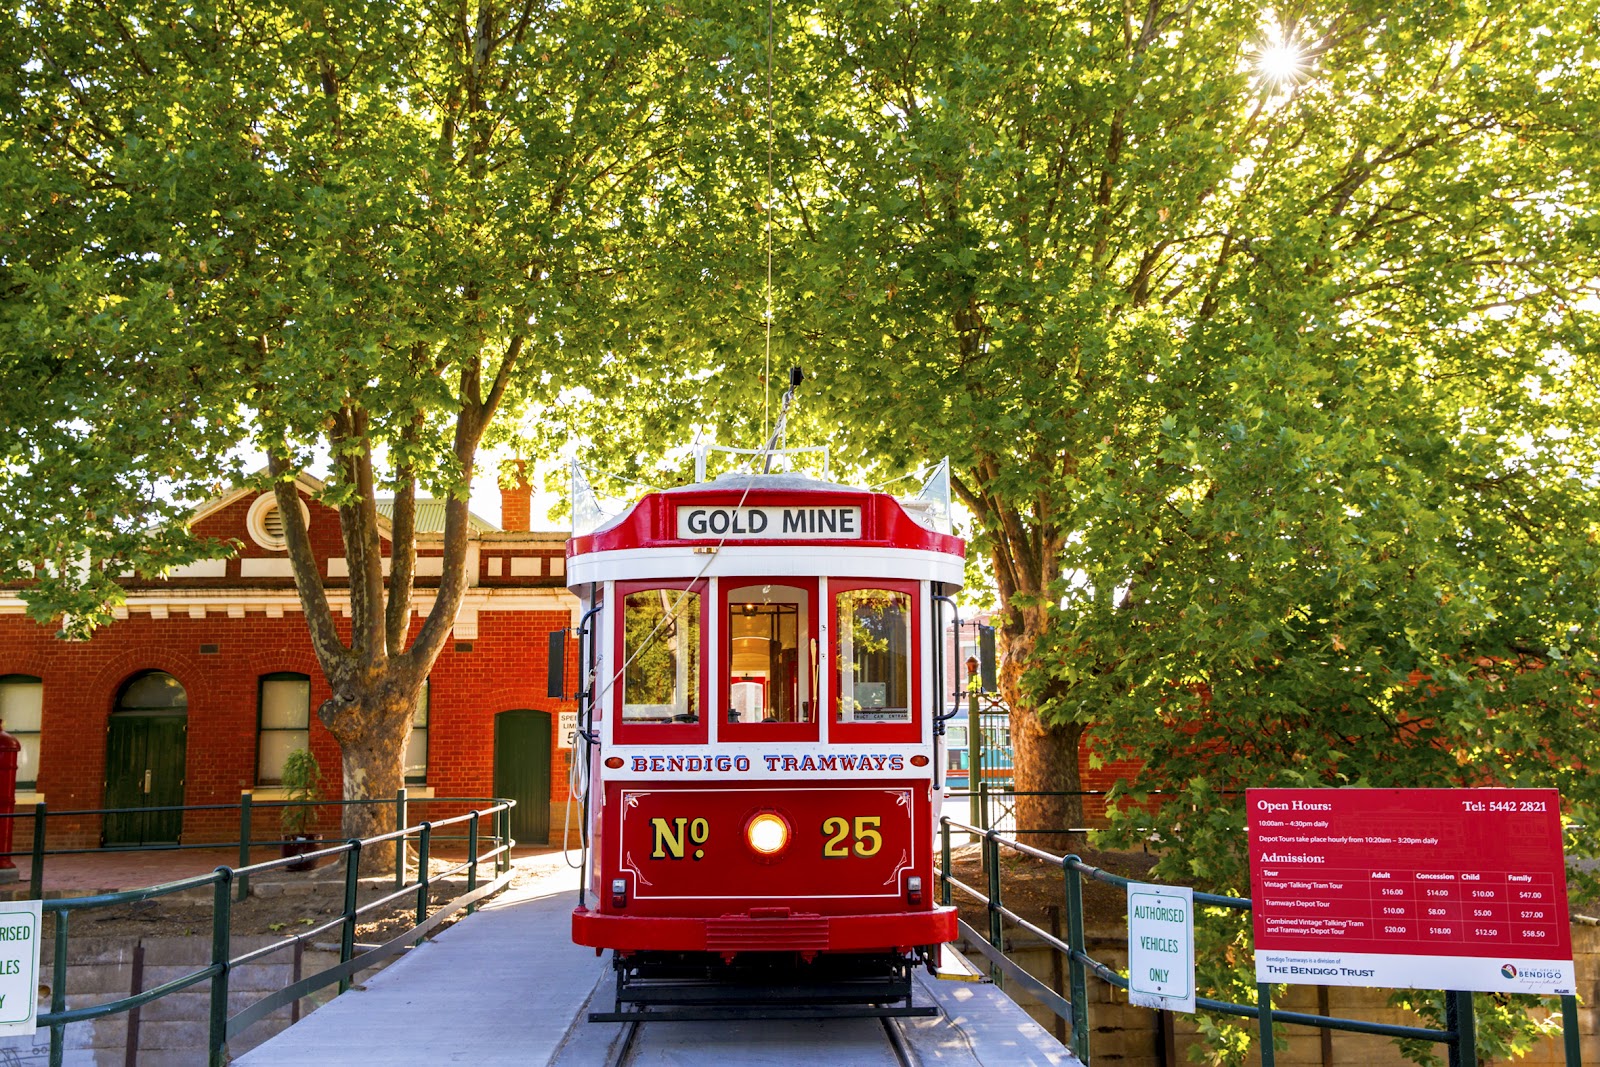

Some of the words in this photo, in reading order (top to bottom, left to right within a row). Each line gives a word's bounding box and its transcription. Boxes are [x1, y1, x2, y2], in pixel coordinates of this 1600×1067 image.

[687, 509, 768, 535] GOLD
[783, 509, 854, 533] MINE
[631, 755, 750, 772] BENDIGO
[763, 754, 904, 772] TRAMWAYS
[1257, 800, 1289, 813] Open
[1292, 800, 1332, 811] Hours:
[1462, 801, 1486, 812] Tel:
[1489, 801, 1517, 812] 5442
[1520, 801, 1546, 812] 2821
[821, 816, 882, 859] 25
[1260, 852, 1325, 863] Admission:
[1134, 905, 1184, 923] AUTHORISED
[1140, 936, 1178, 954] VEHICLES
[1149, 968, 1170, 983] ONLY
[1266, 965, 1288, 974] THE
[1290, 966, 1338, 976] BENDIGO
[1340, 968, 1375, 977] TRUST
